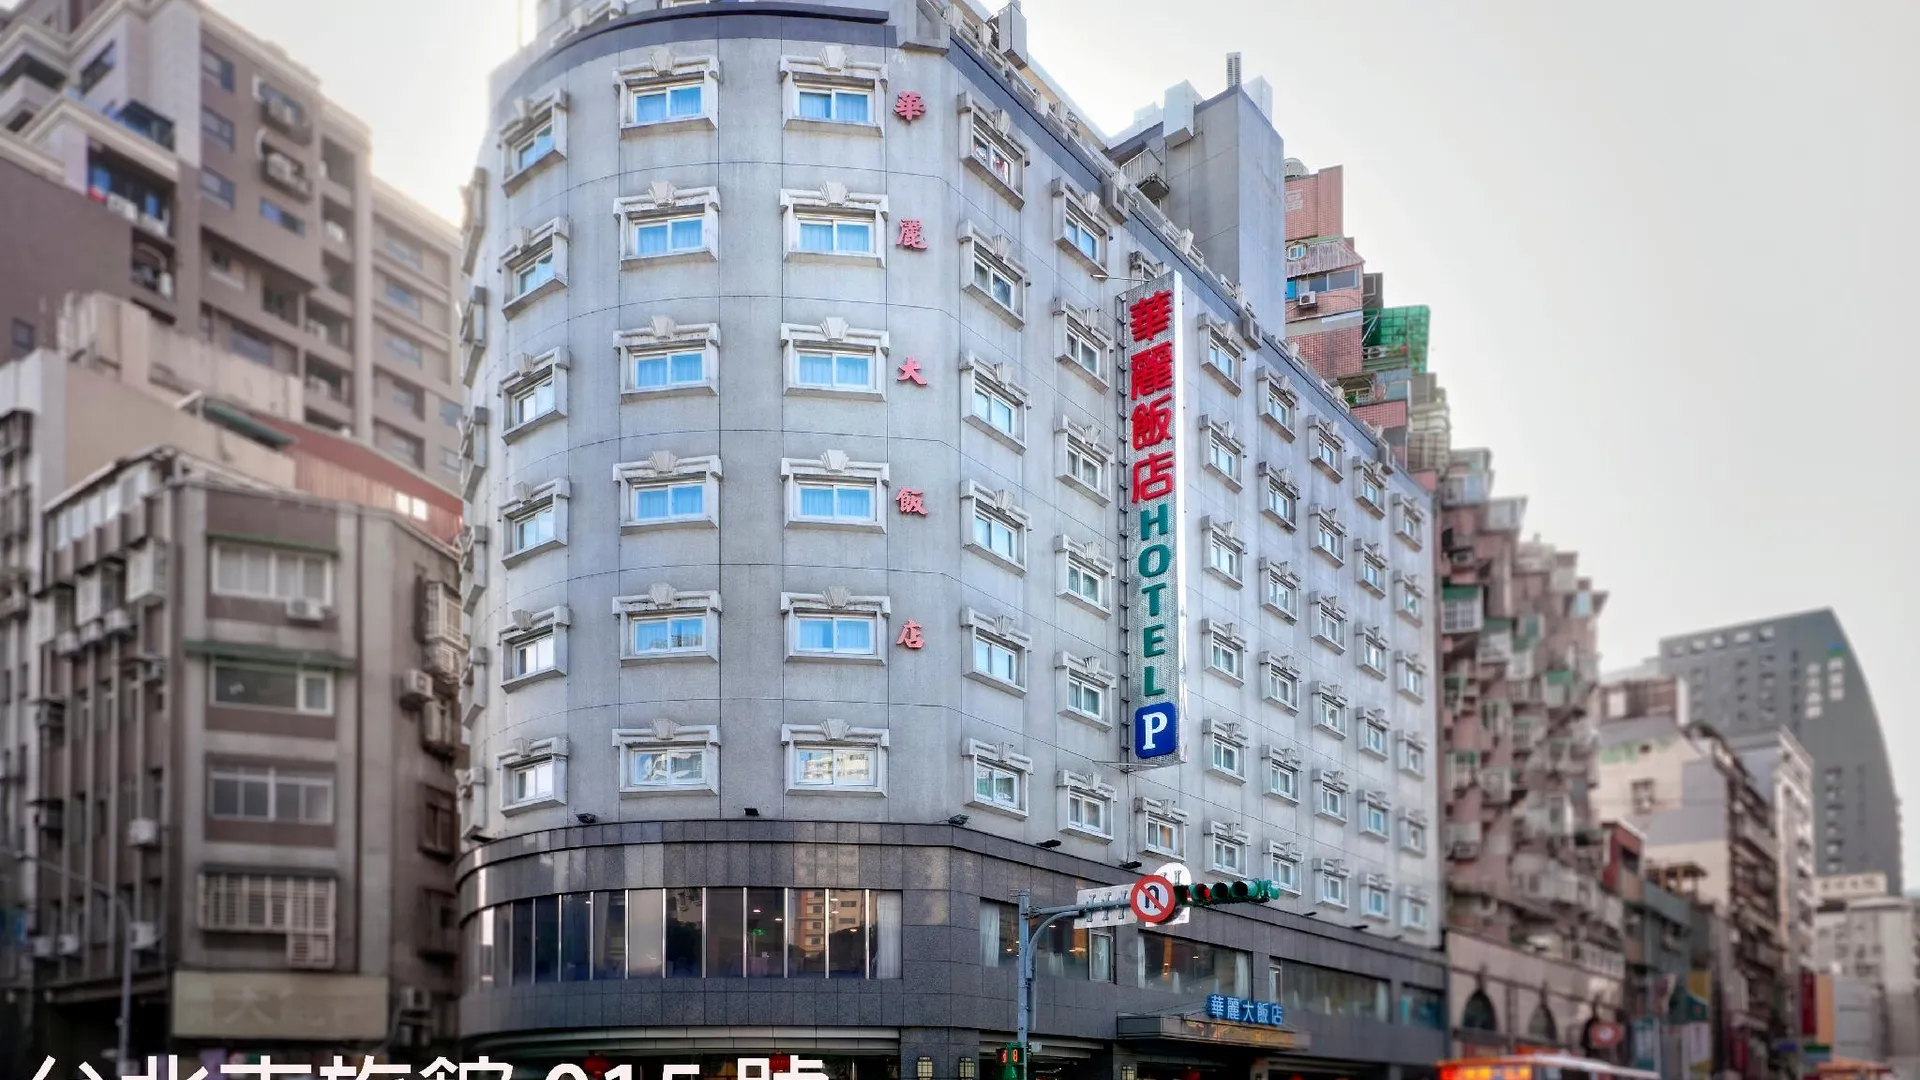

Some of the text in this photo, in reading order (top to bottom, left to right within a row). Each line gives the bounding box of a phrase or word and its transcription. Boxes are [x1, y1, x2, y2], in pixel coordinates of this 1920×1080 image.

[892, 90, 928, 650] 華麗大飯店
[1129, 289, 1174, 504] 華麗飯店
[1138, 503, 1170, 697] HOTEL
[1142, 712, 1168, 750] P
[1211, 994, 1283, 1025] 華麗大飯店
